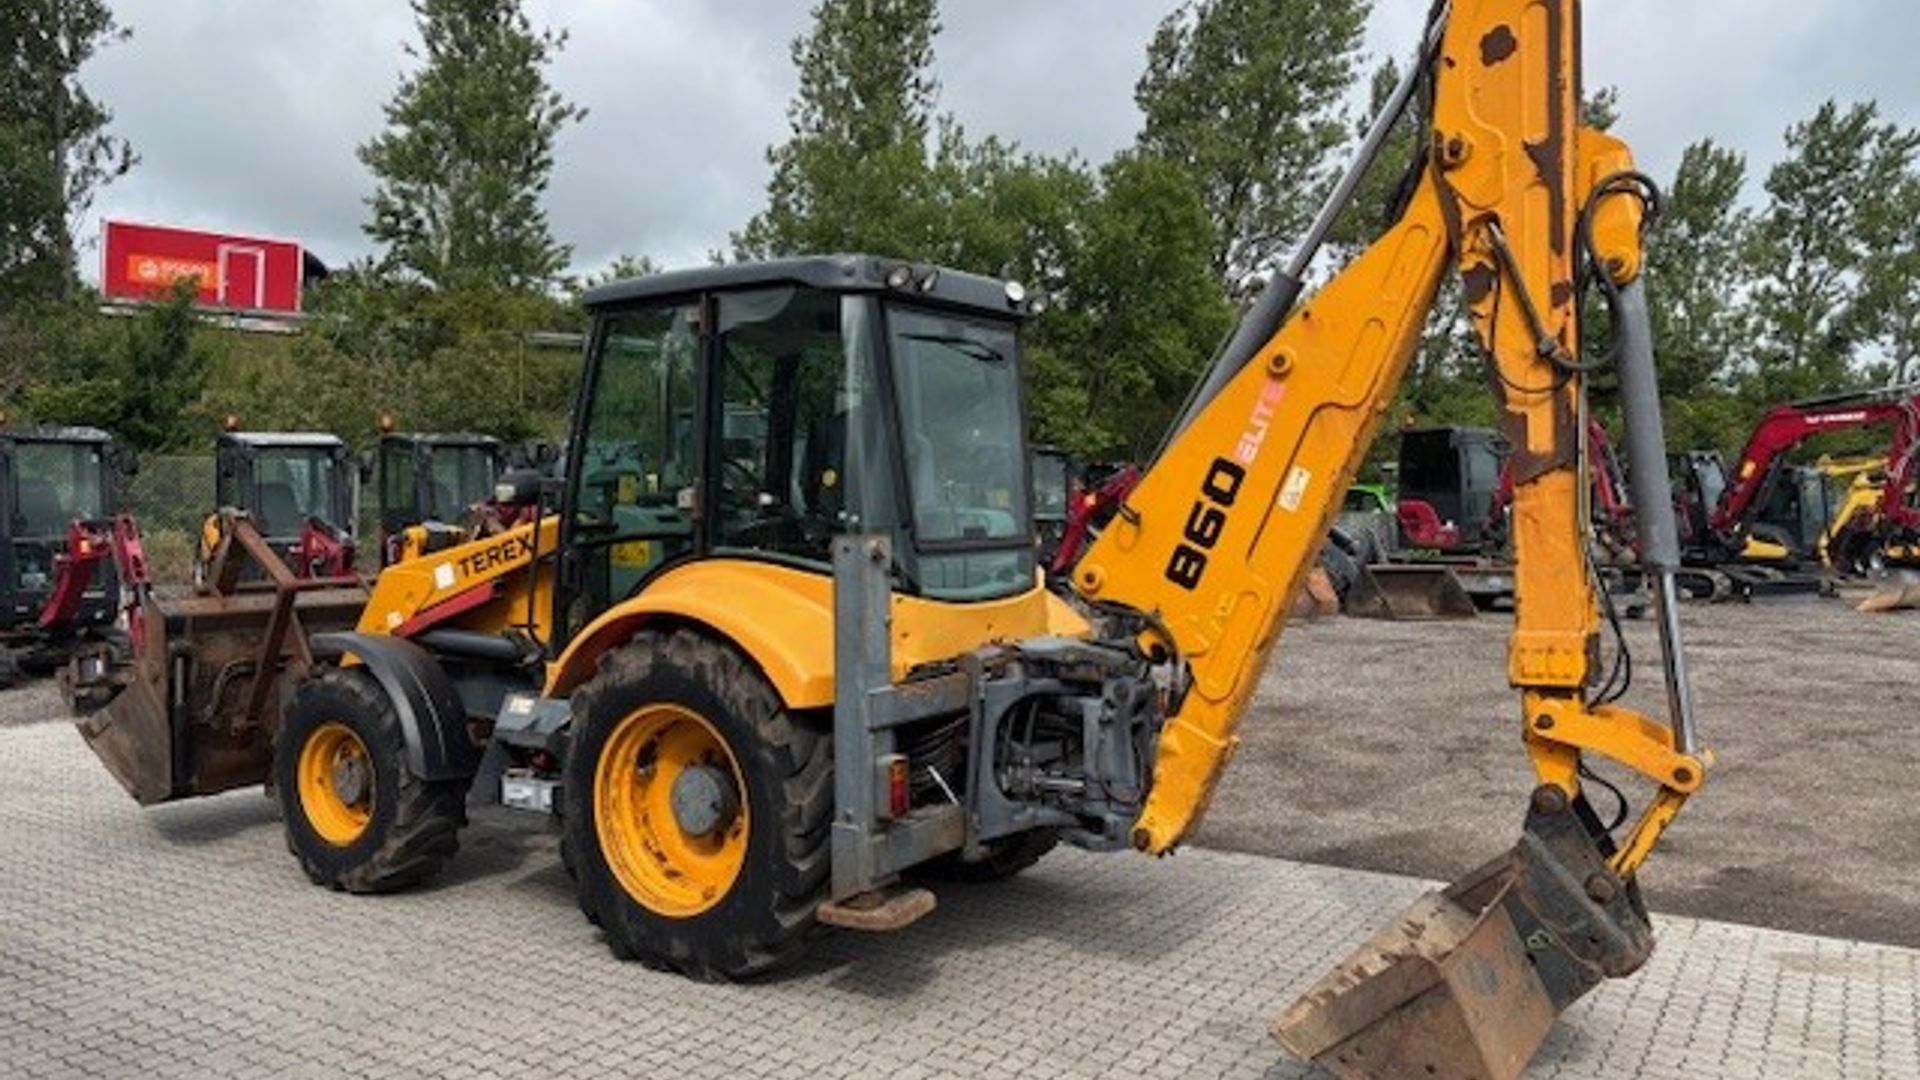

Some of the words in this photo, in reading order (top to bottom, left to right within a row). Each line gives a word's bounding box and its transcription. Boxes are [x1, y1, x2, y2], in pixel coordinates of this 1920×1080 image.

[1165, 456, 1247, 590] 860
[1234, 376, 1287, 465] ELITE
[458, 531, 533, 577] TEREX
